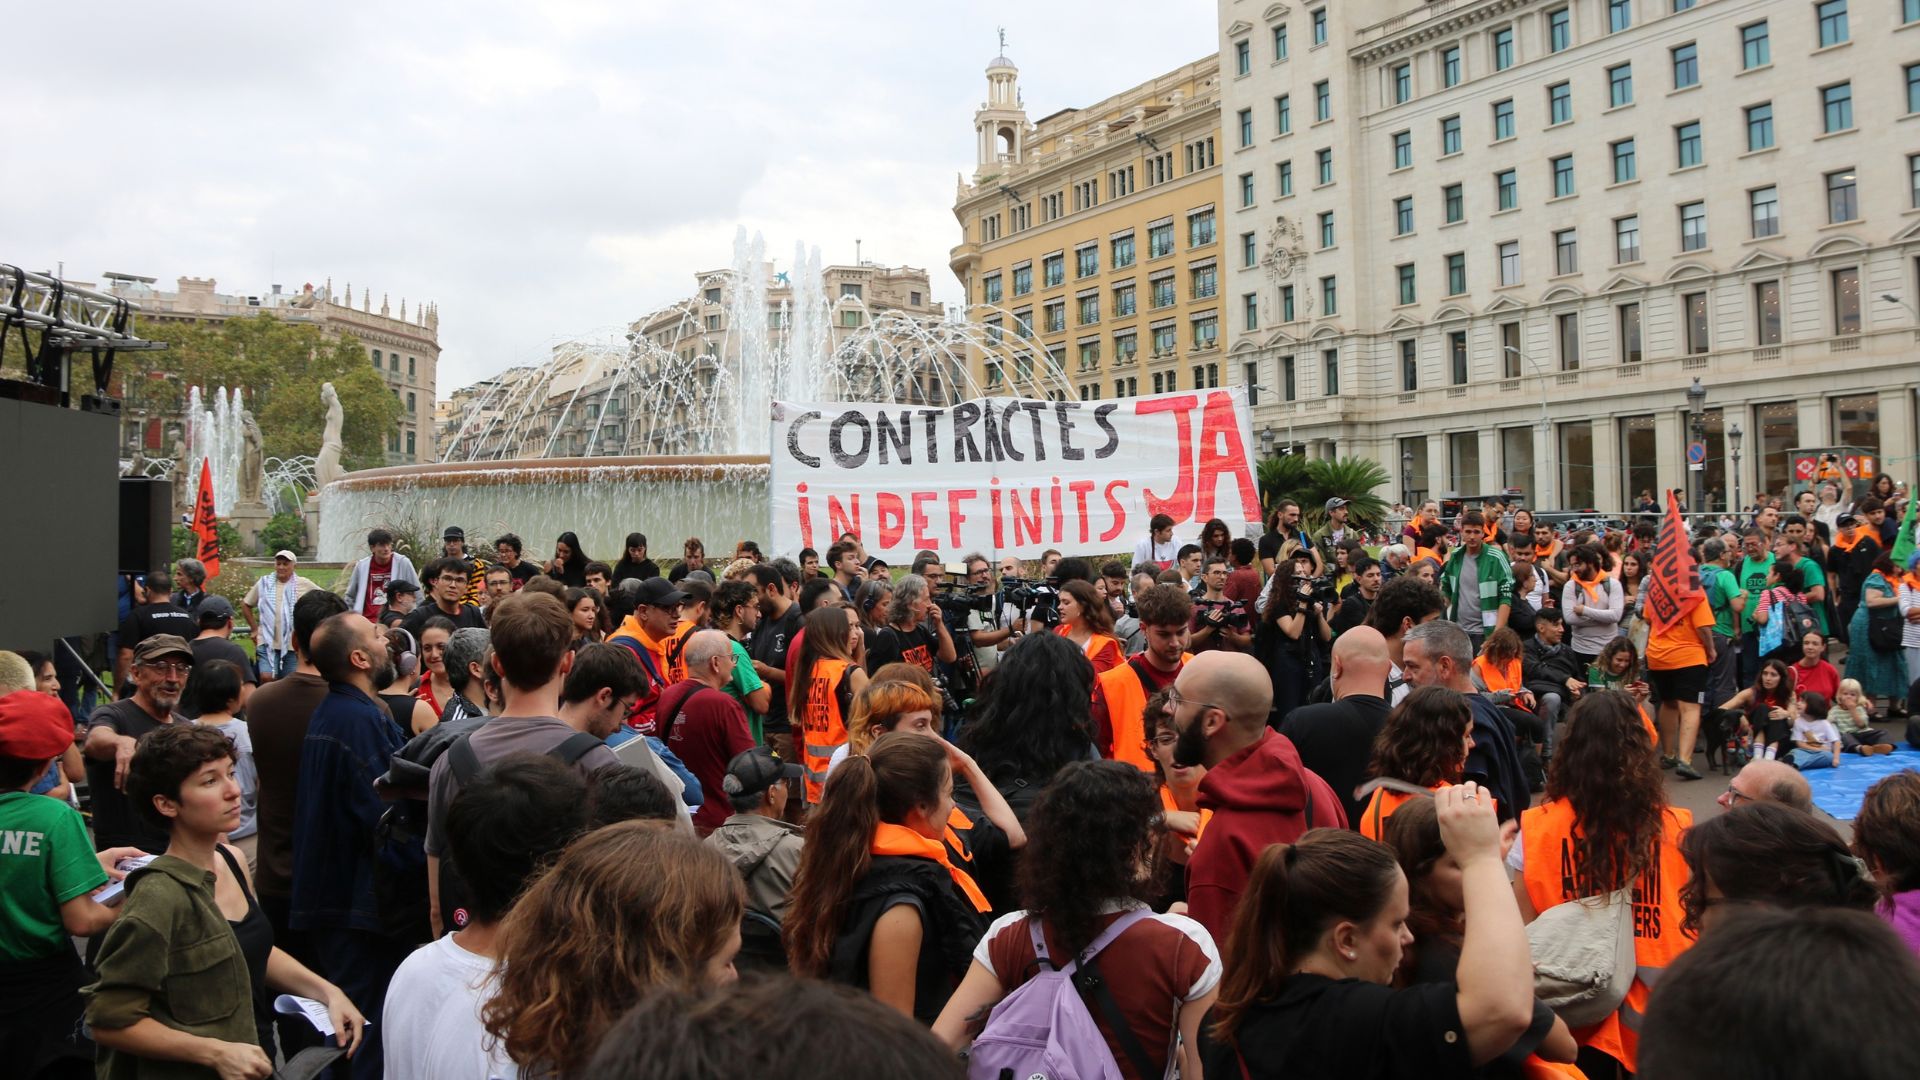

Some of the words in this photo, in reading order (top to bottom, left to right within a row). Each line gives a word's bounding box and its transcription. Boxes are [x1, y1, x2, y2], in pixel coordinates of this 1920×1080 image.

[787, 399, 1119, 468] CONTRACTES
[1135, 390, 1263, 526] JA
[0, 830, 45, 857] NE
